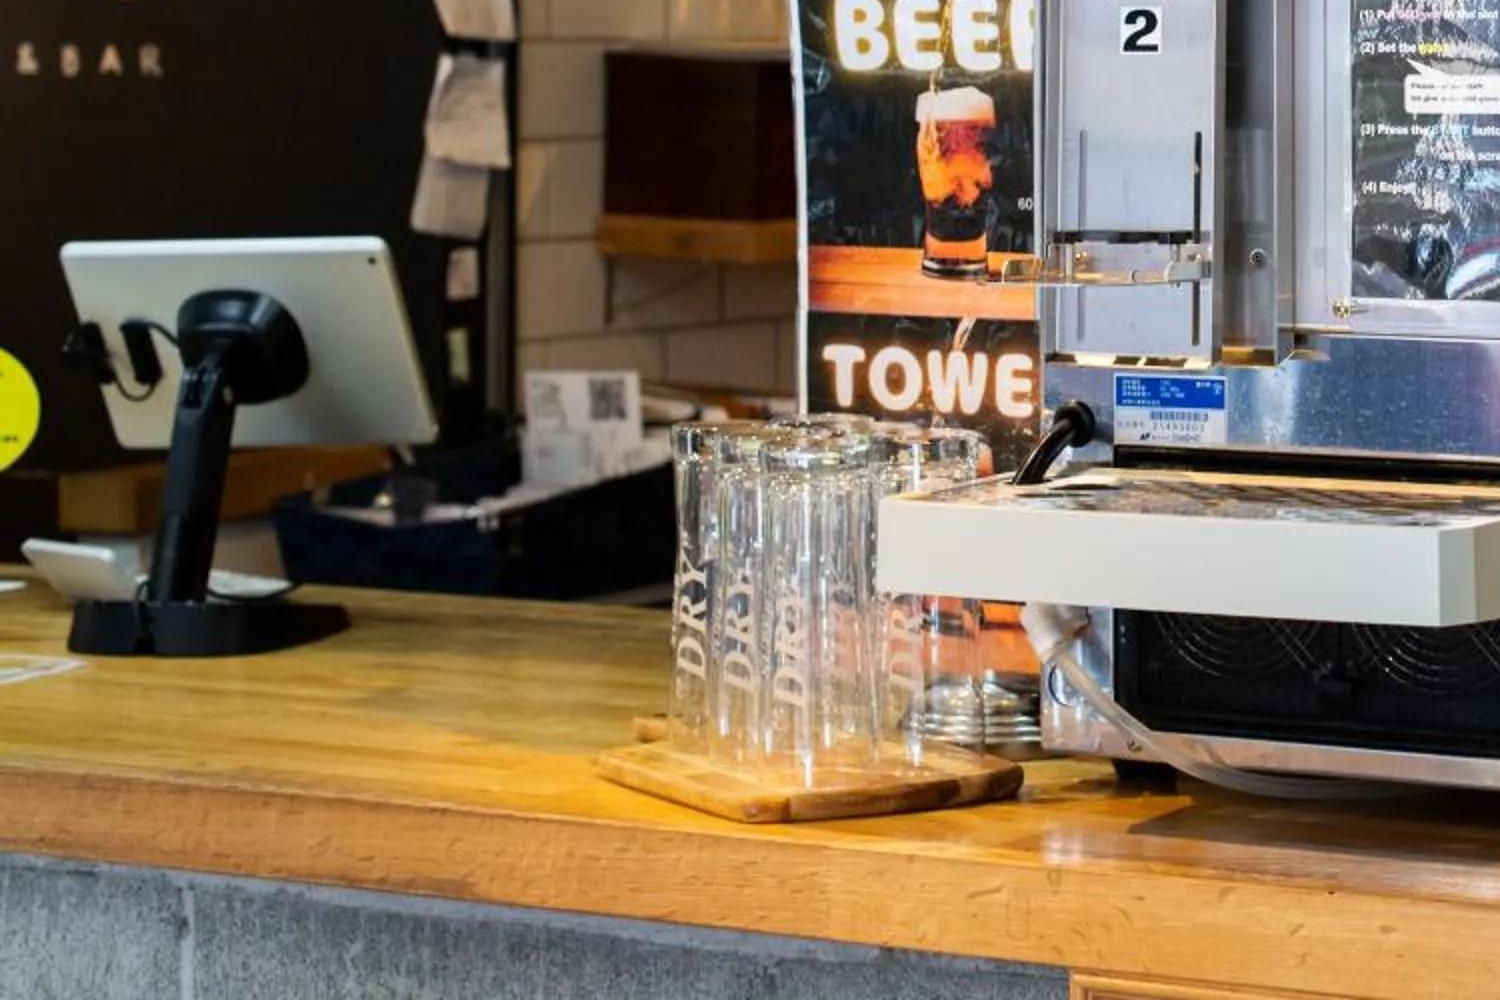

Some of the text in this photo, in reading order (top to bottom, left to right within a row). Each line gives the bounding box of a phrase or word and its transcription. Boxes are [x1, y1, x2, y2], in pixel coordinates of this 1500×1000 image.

[1122, 8, 1160, 53] 2
[1377, 123, 1409, 136] Press
[1017, 197, 1033, 211] 60
[821, 343, 1035, 419] TOWE
[888, 594, 925, 694] DR
